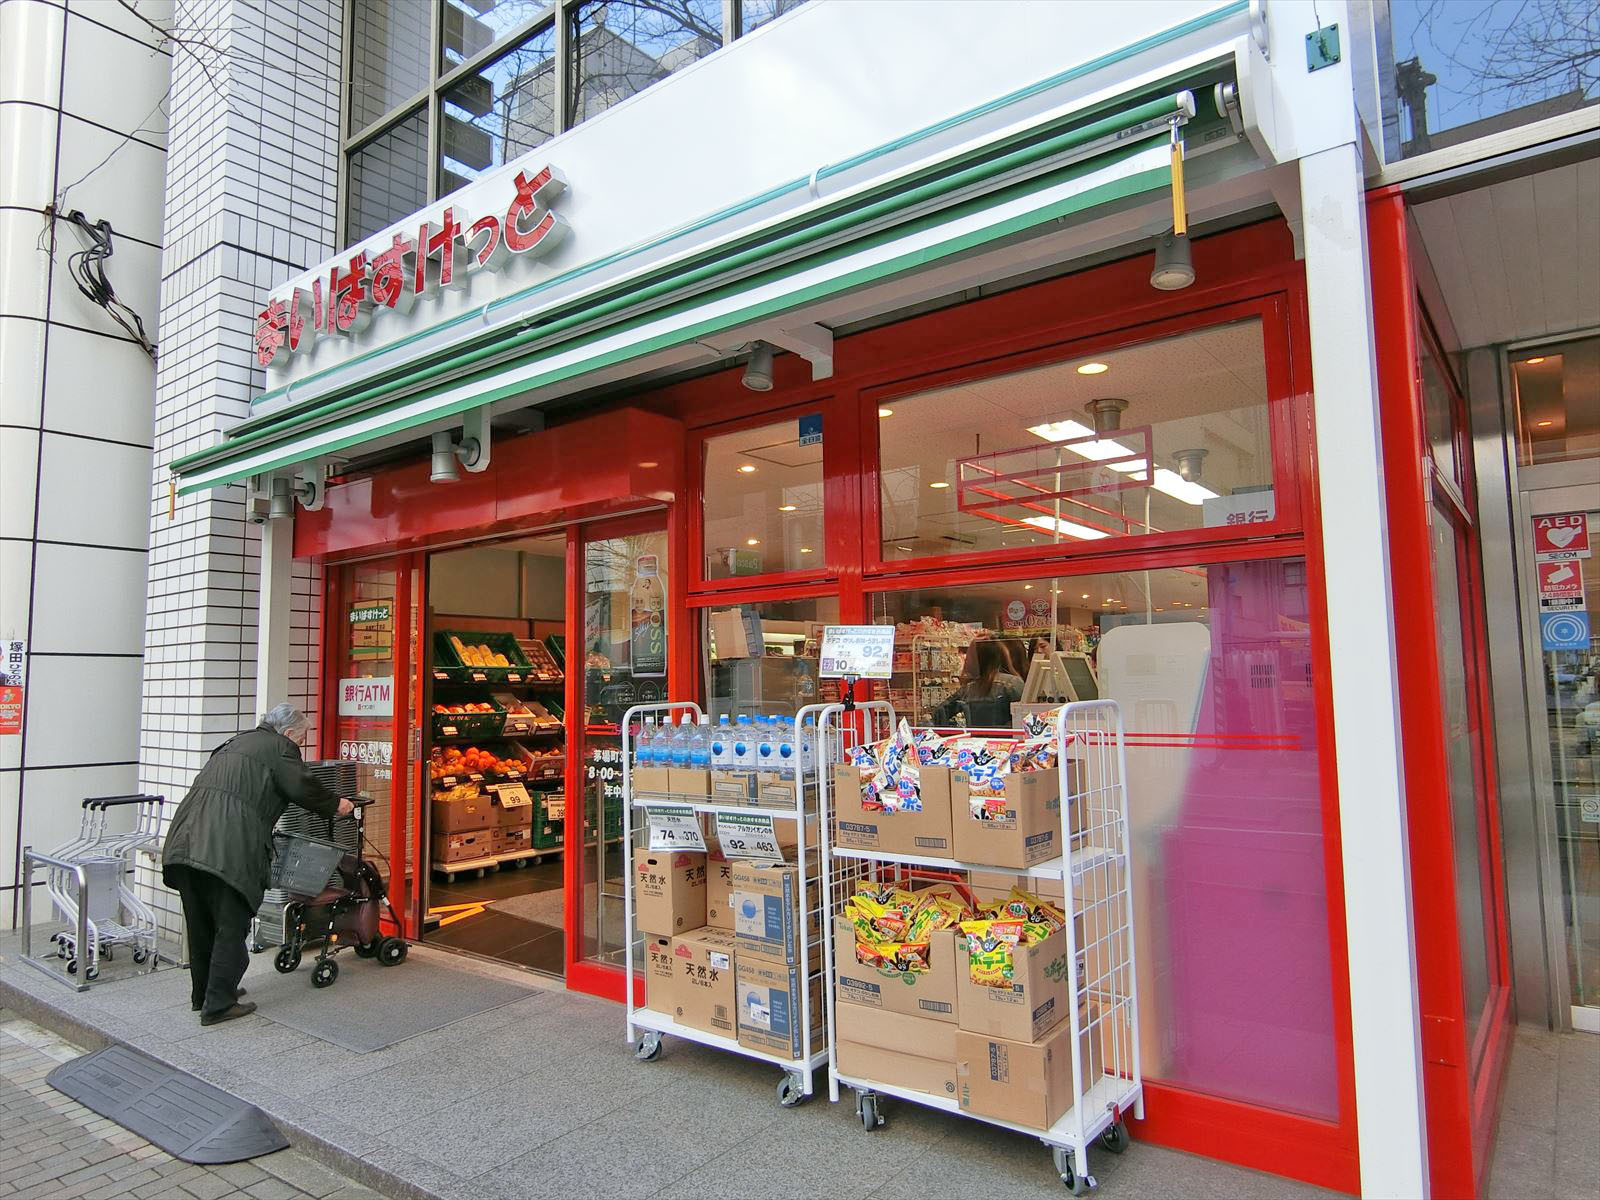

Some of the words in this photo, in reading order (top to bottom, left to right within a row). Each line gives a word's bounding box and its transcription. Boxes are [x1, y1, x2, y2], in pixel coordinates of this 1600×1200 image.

[255, 163, 556, 367] まいばすけっと
[1538, 516, 1582, 528] AED
[1548, 552, 1577, 560] SECOM
[1544, 584, 1577, 592] 防犯カメラ
[350, 607, 388, 622] まいばすけっと
[648, 596, 661, 654] BOSS
[862, 645, 883, 658] 92
[835, 659, 848, 671] 10
[345, 684, 390, 702] 銀行ATM
[961, 764, 996, 782] ポテコ
[510, 796, 521, 804] 99
[557, 809, 565, 818] 39
[660, 829, 675, 840] 74
[685, 831, 698, 841] 370
[729, 839, 747, 850] 92
[757, 841, 775, 852] 463
[640, 873, 666, 885] 天然水
[971, 951, 1006, 969] ポテコ
[686, 962, 719, 981] 天然水
